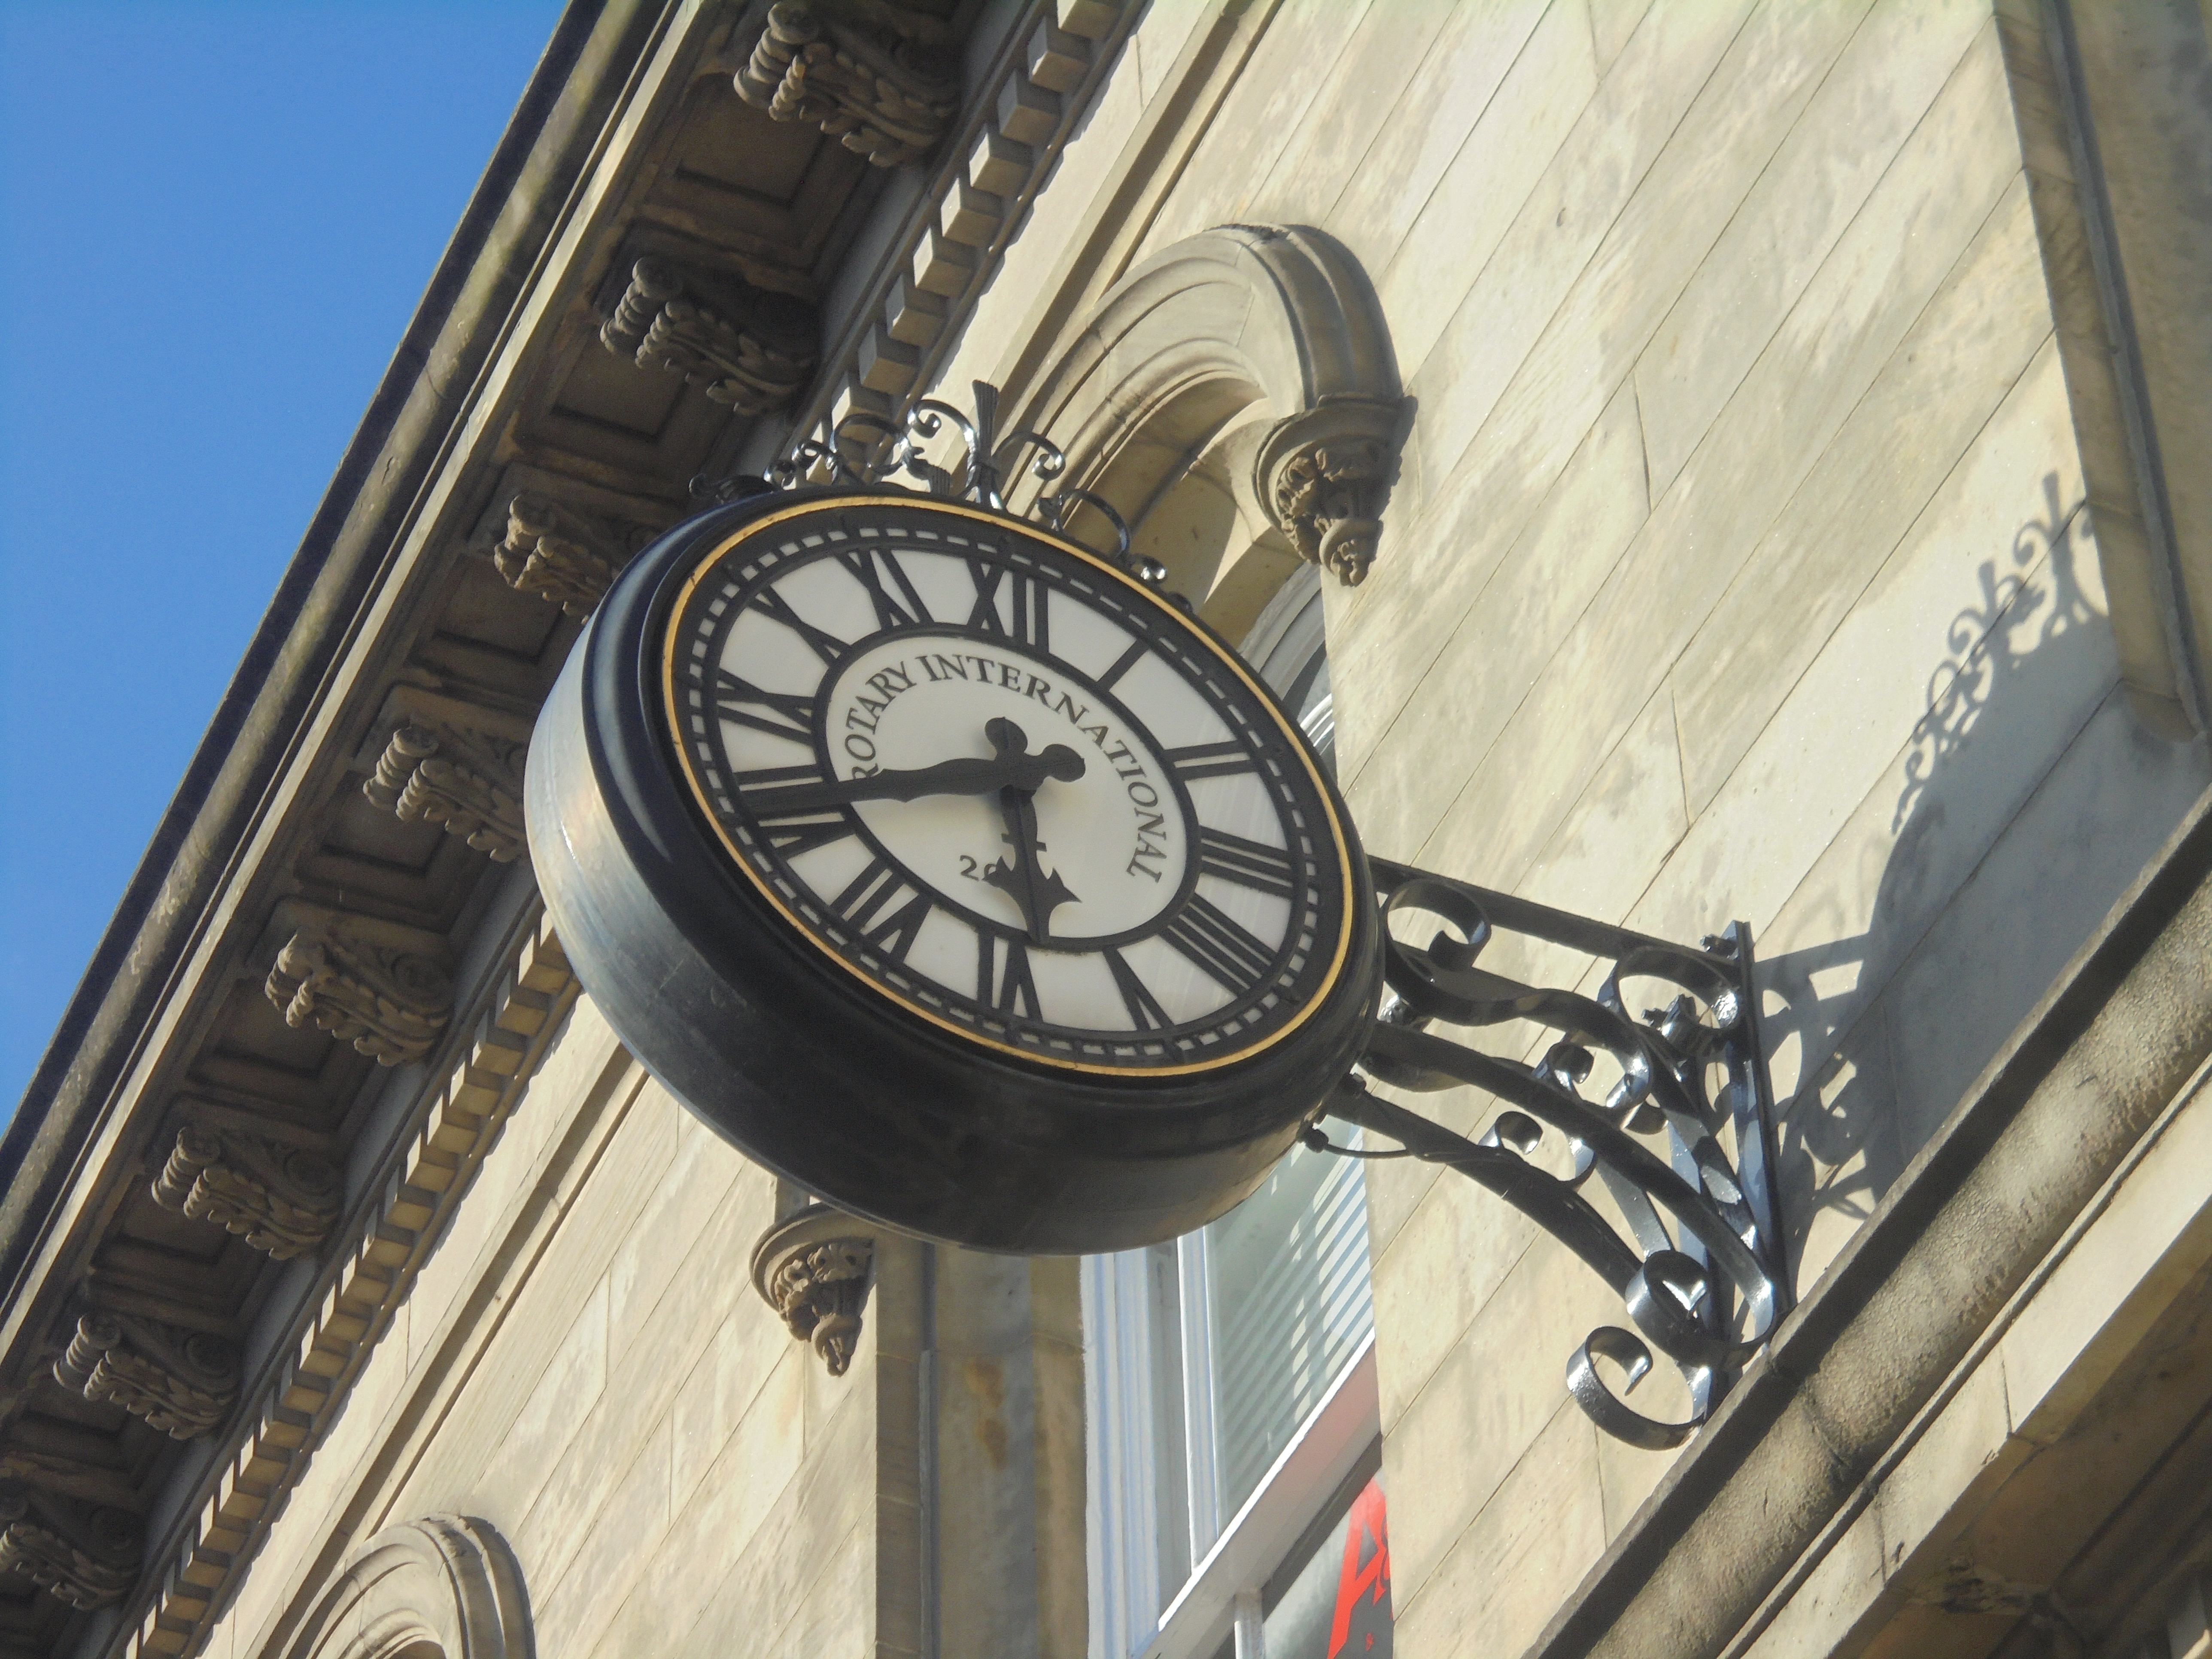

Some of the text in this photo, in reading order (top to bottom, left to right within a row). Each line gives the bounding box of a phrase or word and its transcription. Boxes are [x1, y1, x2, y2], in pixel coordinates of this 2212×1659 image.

[746, 585, 852, 669] X
[963, 557, 1049, 653] XII
[715, 668, 816, 746] IX
[1097, 640, 1149, 692] I
[845, 653, 1167, 883] ROTARY INTERNATIONAL
[1163, 739, 1256, 782] II
[731, 764, 854, 861] VII
[1198, 825, 1292, 899] III
[828, 858, 933, 964] VII
[1158, 892, 1279, 998] IIII
[976, 933, 1044, 1023] VI
[1102, 948, 1176, 1030] V
